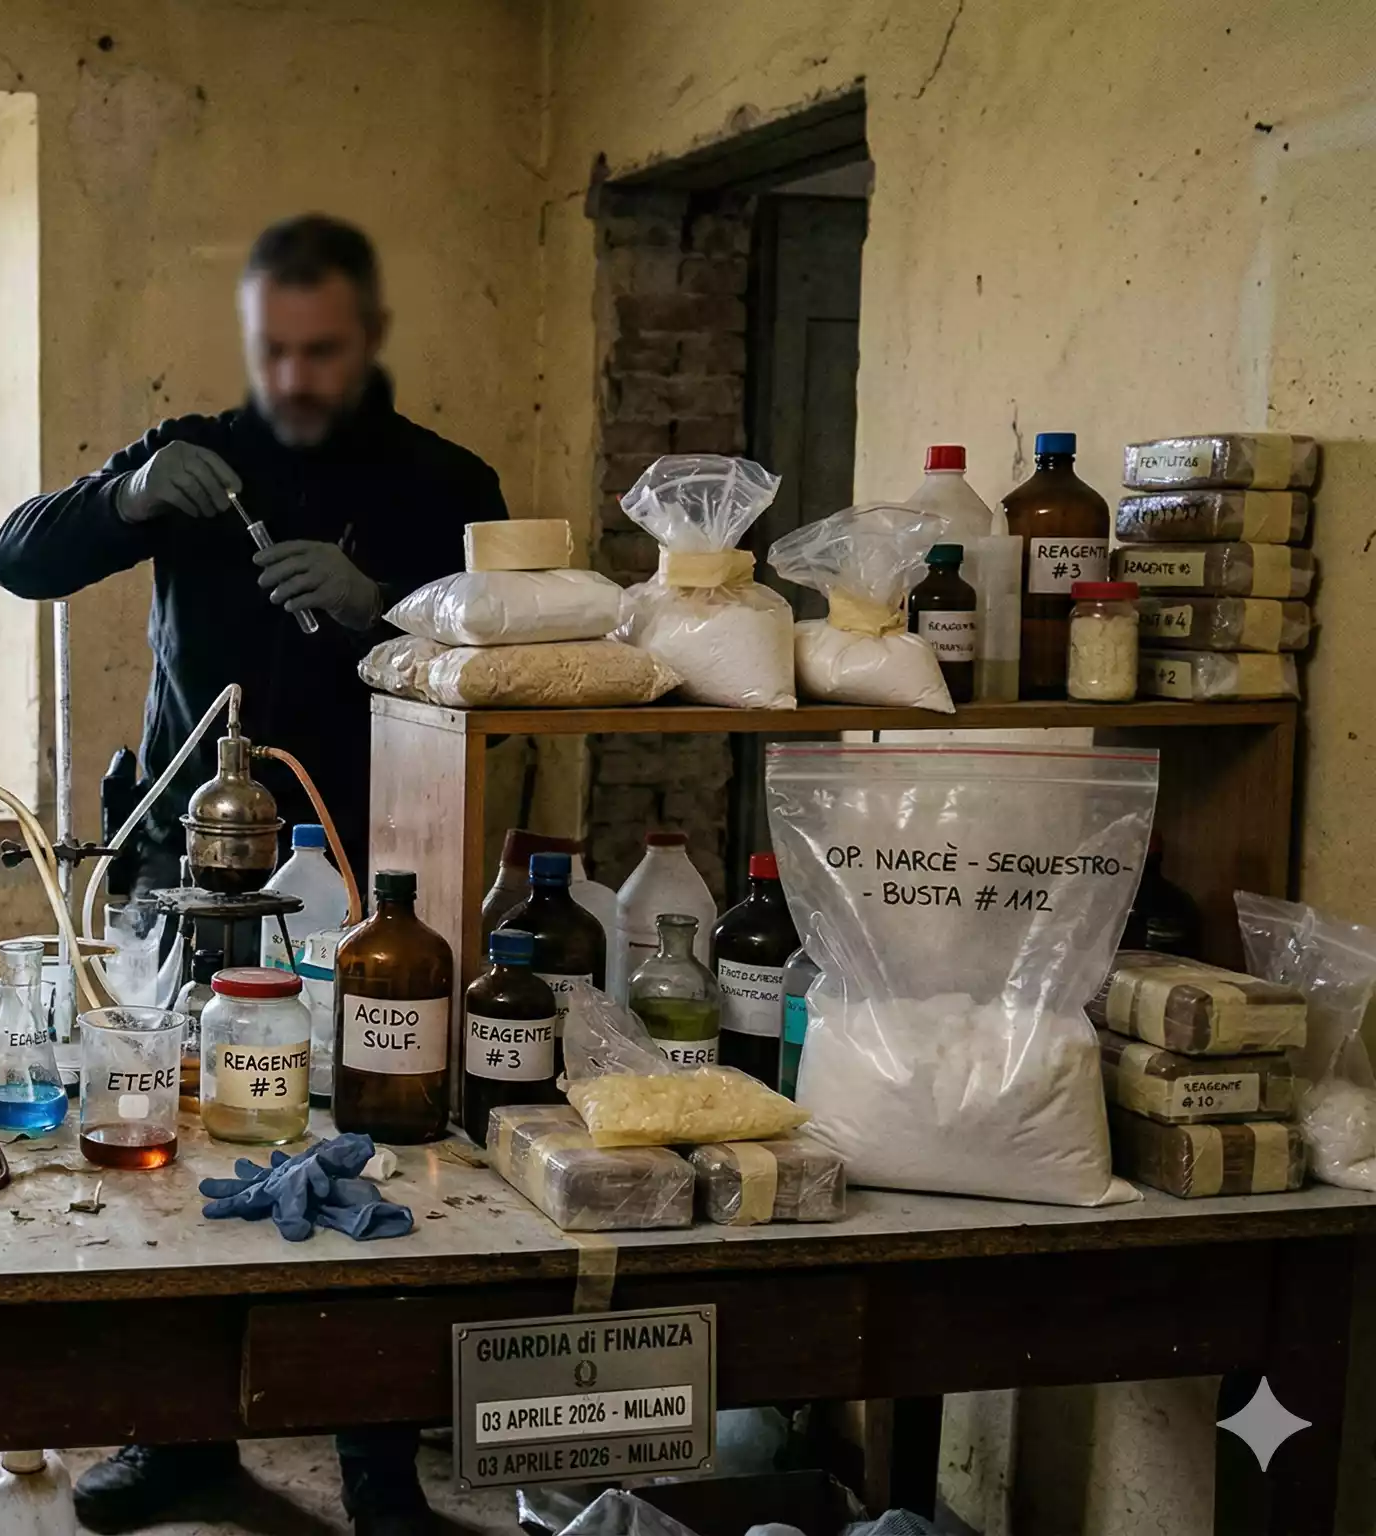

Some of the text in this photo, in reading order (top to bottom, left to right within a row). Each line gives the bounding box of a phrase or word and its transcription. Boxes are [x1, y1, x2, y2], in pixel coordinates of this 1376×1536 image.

[1052, 562, 1081, 579] #3
[827, 846, 863, 868] OP.
[876, 842, 958, 871] NARCÈ
[883, 881, 962, 906] BUSTA
[355, 1004, 419, 1026] ACIDO
[363, 1030, 421, 1050] SULF.
[471, 1021, 552, 1043] REAGENTE
[224, 1051, 307, 1071] REAGENTE
[485, 1048, 522, 1069] #3
[108, 1067, 175, 1091] ETERE
[250, 1077, 287, 1097] #3
[476, 1323, 693, 1362] GUARDIA di FINANZA
[482, 1412, 501, 1431] 03
[507, 1406, 563, 1429] APRILE
[569, 1402, 606, 1425] 2026
[624, 1395, 686, 1419] MILANO
[478, 1458, 498, 1477] 03
[503, 1450, 563, 1474] APRILE
[569, 1446, 610, 1469] 2026
[628, 1440, 693, 1463] MILANO
